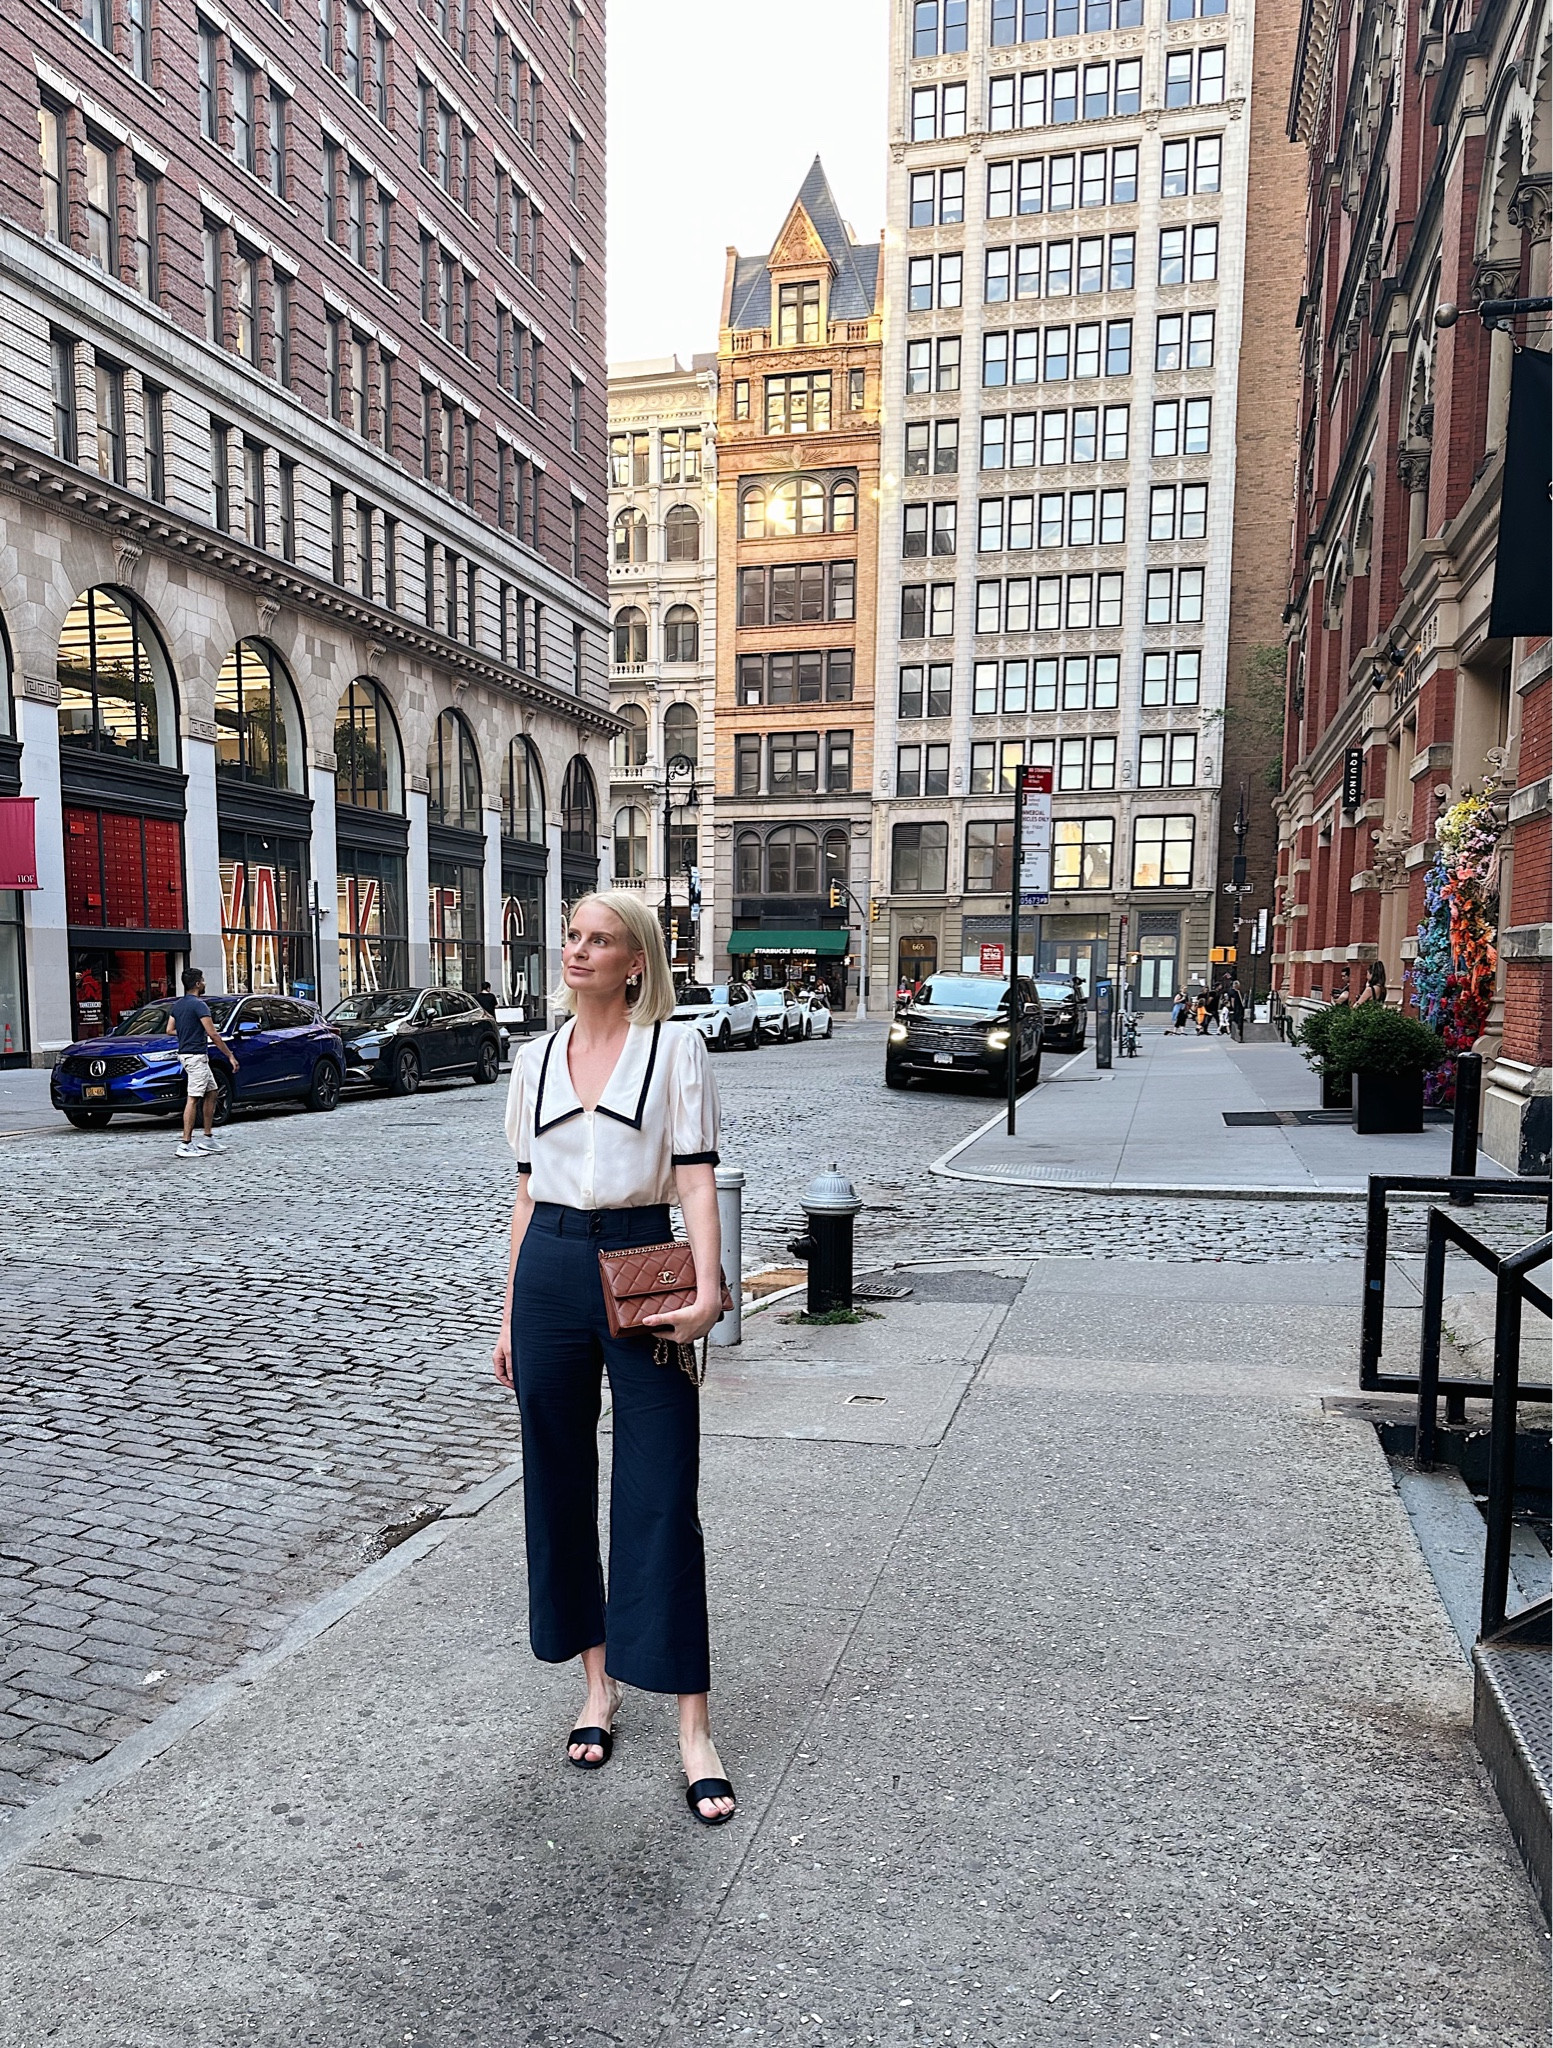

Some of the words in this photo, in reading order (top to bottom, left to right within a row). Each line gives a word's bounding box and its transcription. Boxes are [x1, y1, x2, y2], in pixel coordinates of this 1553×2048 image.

[1348, 752, 1359, 803] EQUINOX
[298, 990, 305, 1000] P
[1100, 987, 1107, 997] P
